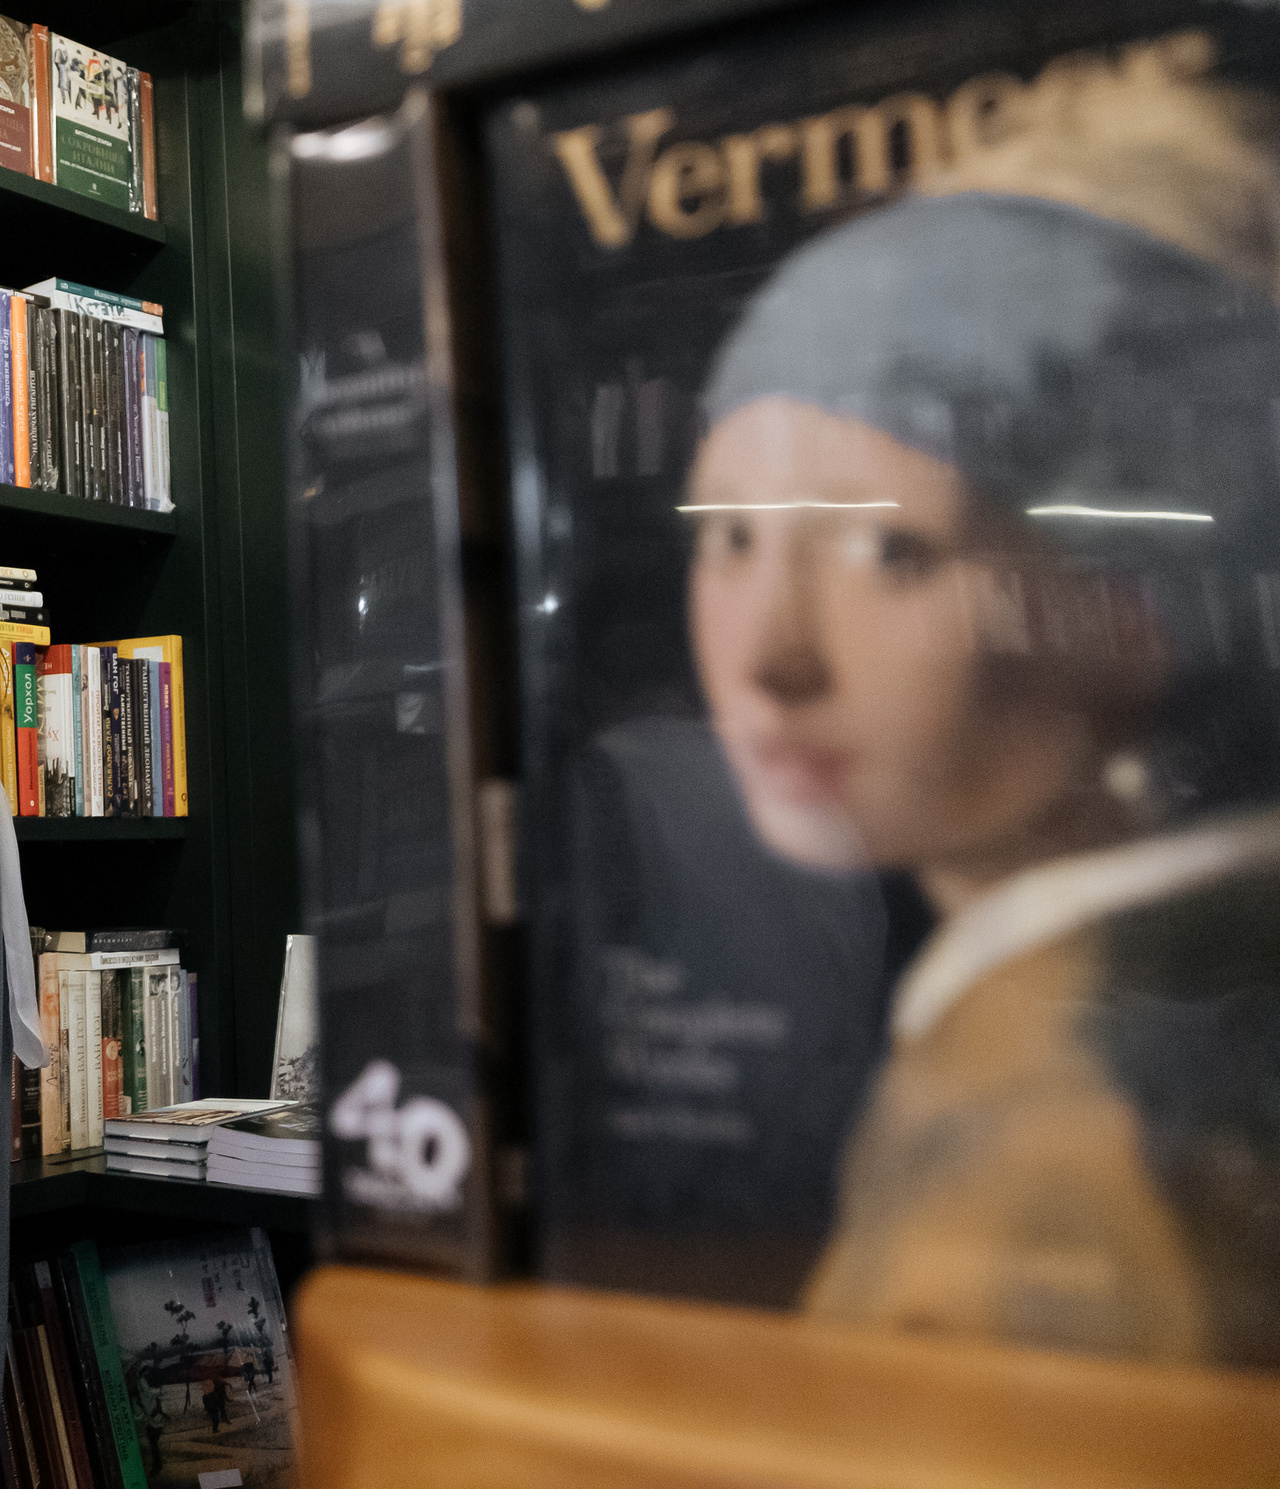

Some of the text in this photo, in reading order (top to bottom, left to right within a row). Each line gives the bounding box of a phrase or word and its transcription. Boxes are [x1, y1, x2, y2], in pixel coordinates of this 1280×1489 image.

[3, 361, 11, 407] живопись
[24, 673, 33, 723] Уорхол
[142, 666, 150, 743] ТАИНСТВЕННЫЙ
[106, 745, 114, 797] САЛЬВАДОР
[329, 1058, 471, 1205] 40
